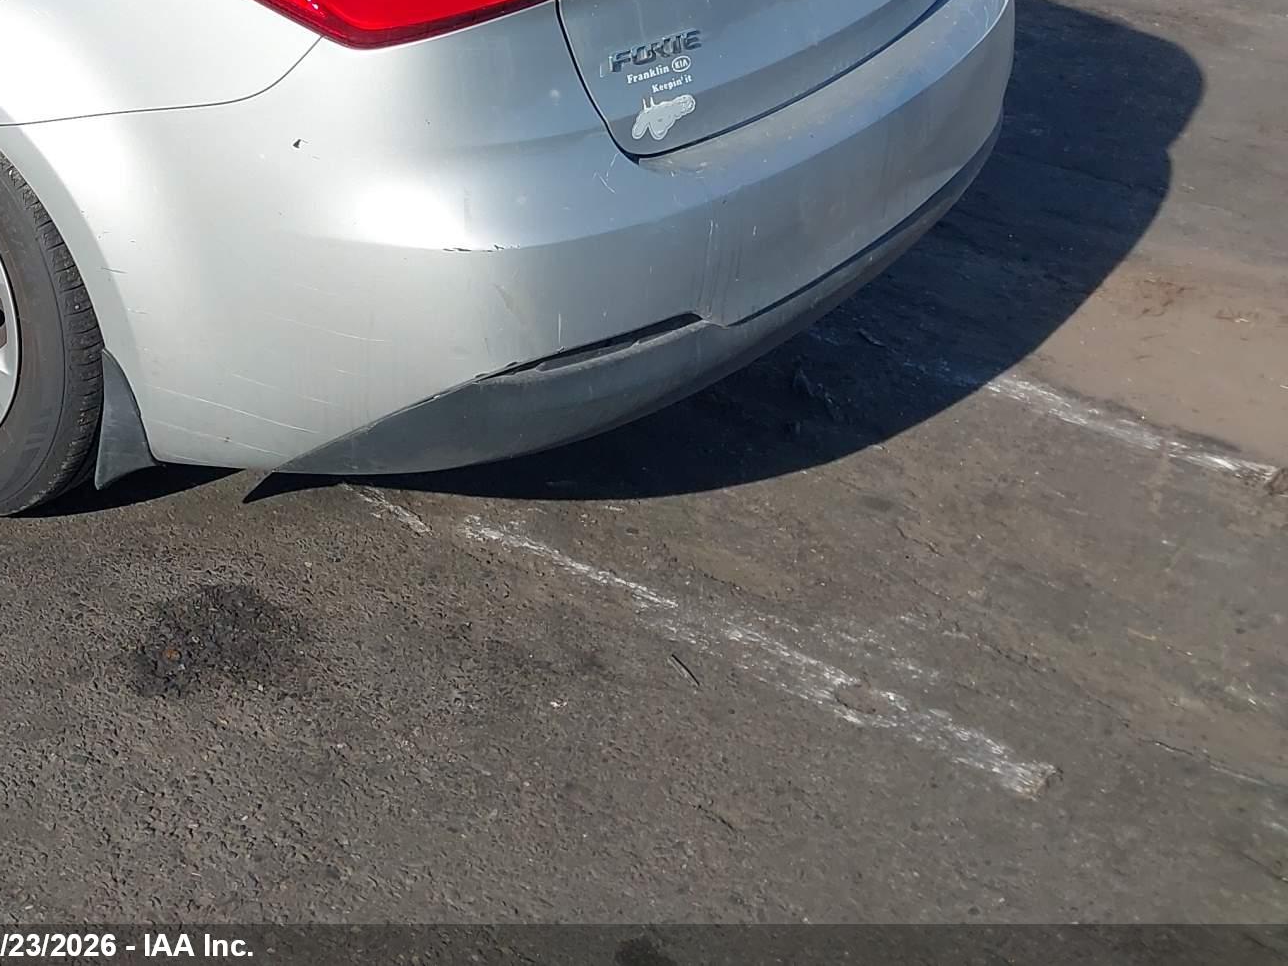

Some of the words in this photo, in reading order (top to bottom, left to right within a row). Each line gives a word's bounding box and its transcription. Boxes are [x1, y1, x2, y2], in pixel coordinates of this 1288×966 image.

[609, 29, 702, 72] FORTE
[626, 64, 670, 84] Franklin
[684, 74, 693, 84] it
